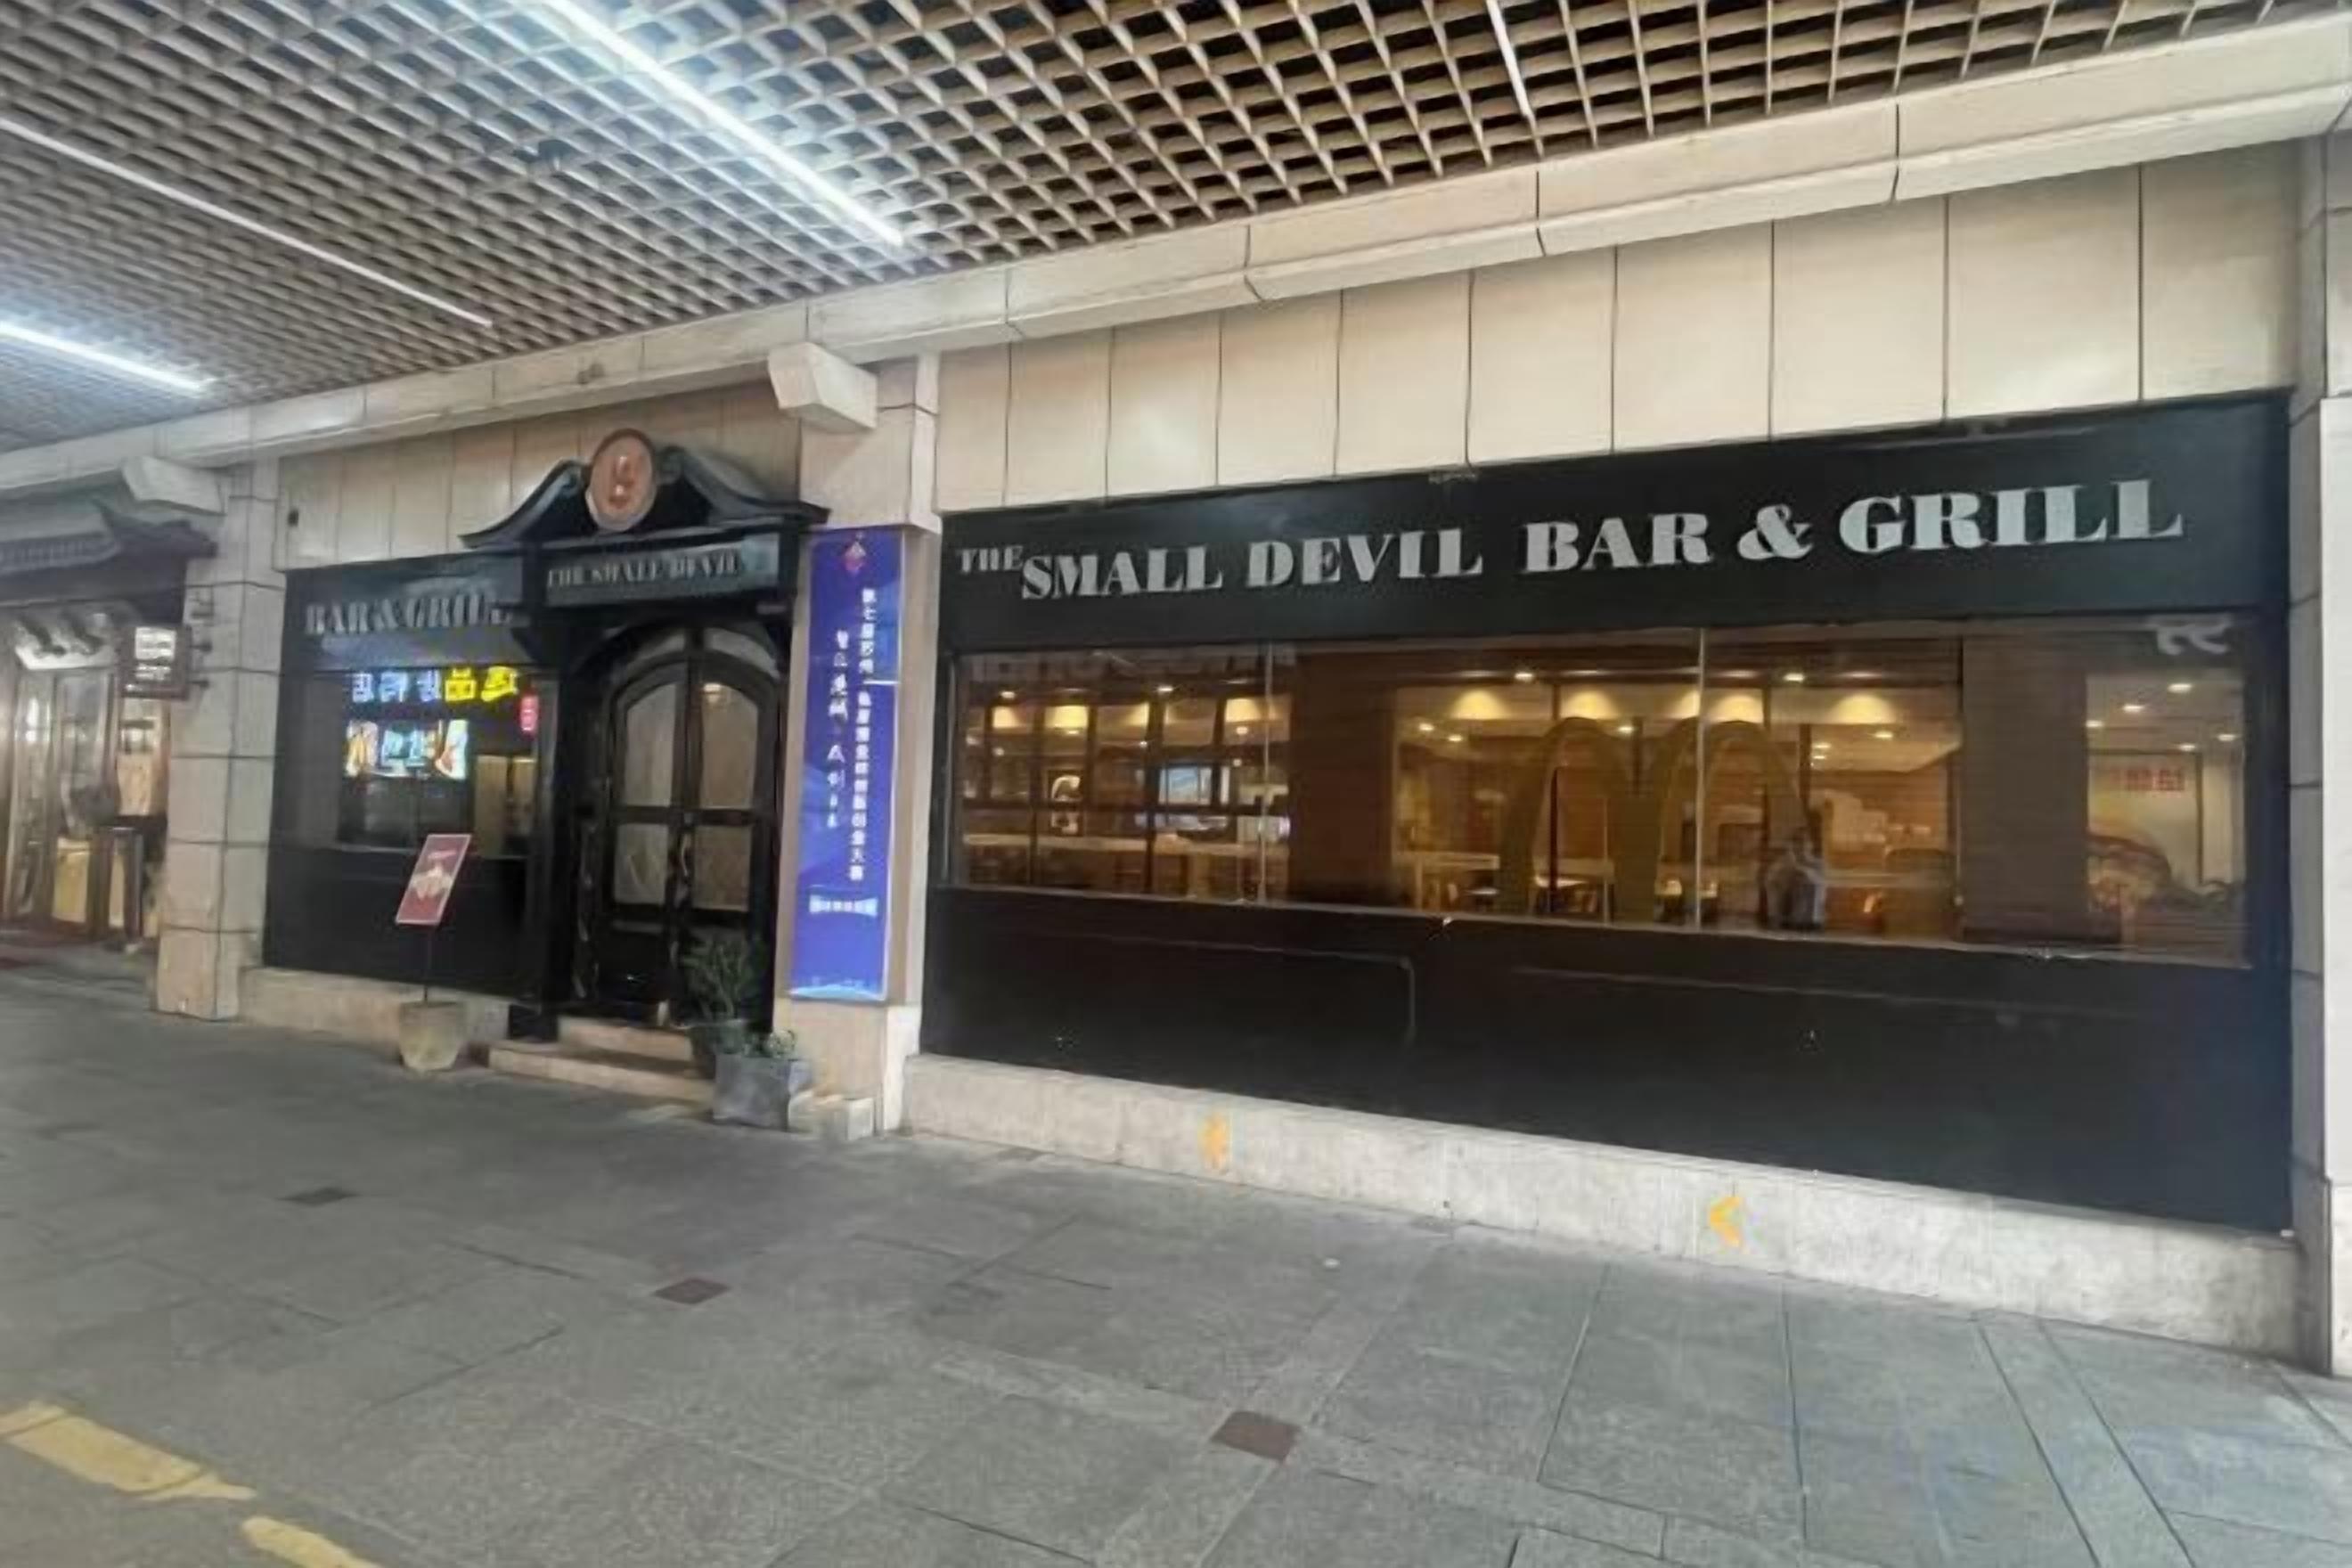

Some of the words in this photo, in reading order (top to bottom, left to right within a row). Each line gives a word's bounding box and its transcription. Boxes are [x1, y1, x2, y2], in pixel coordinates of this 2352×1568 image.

[960, 545, 1024, 573] THE
[1022, 546, 1223, 599] SMALL
[1248, 528, 1483, 588] DEVIL
[1521, 513, 1711, 574] BAR
[1737, 504, 1813, 559] &
[1839, 479, 2184, 554] GRILL
